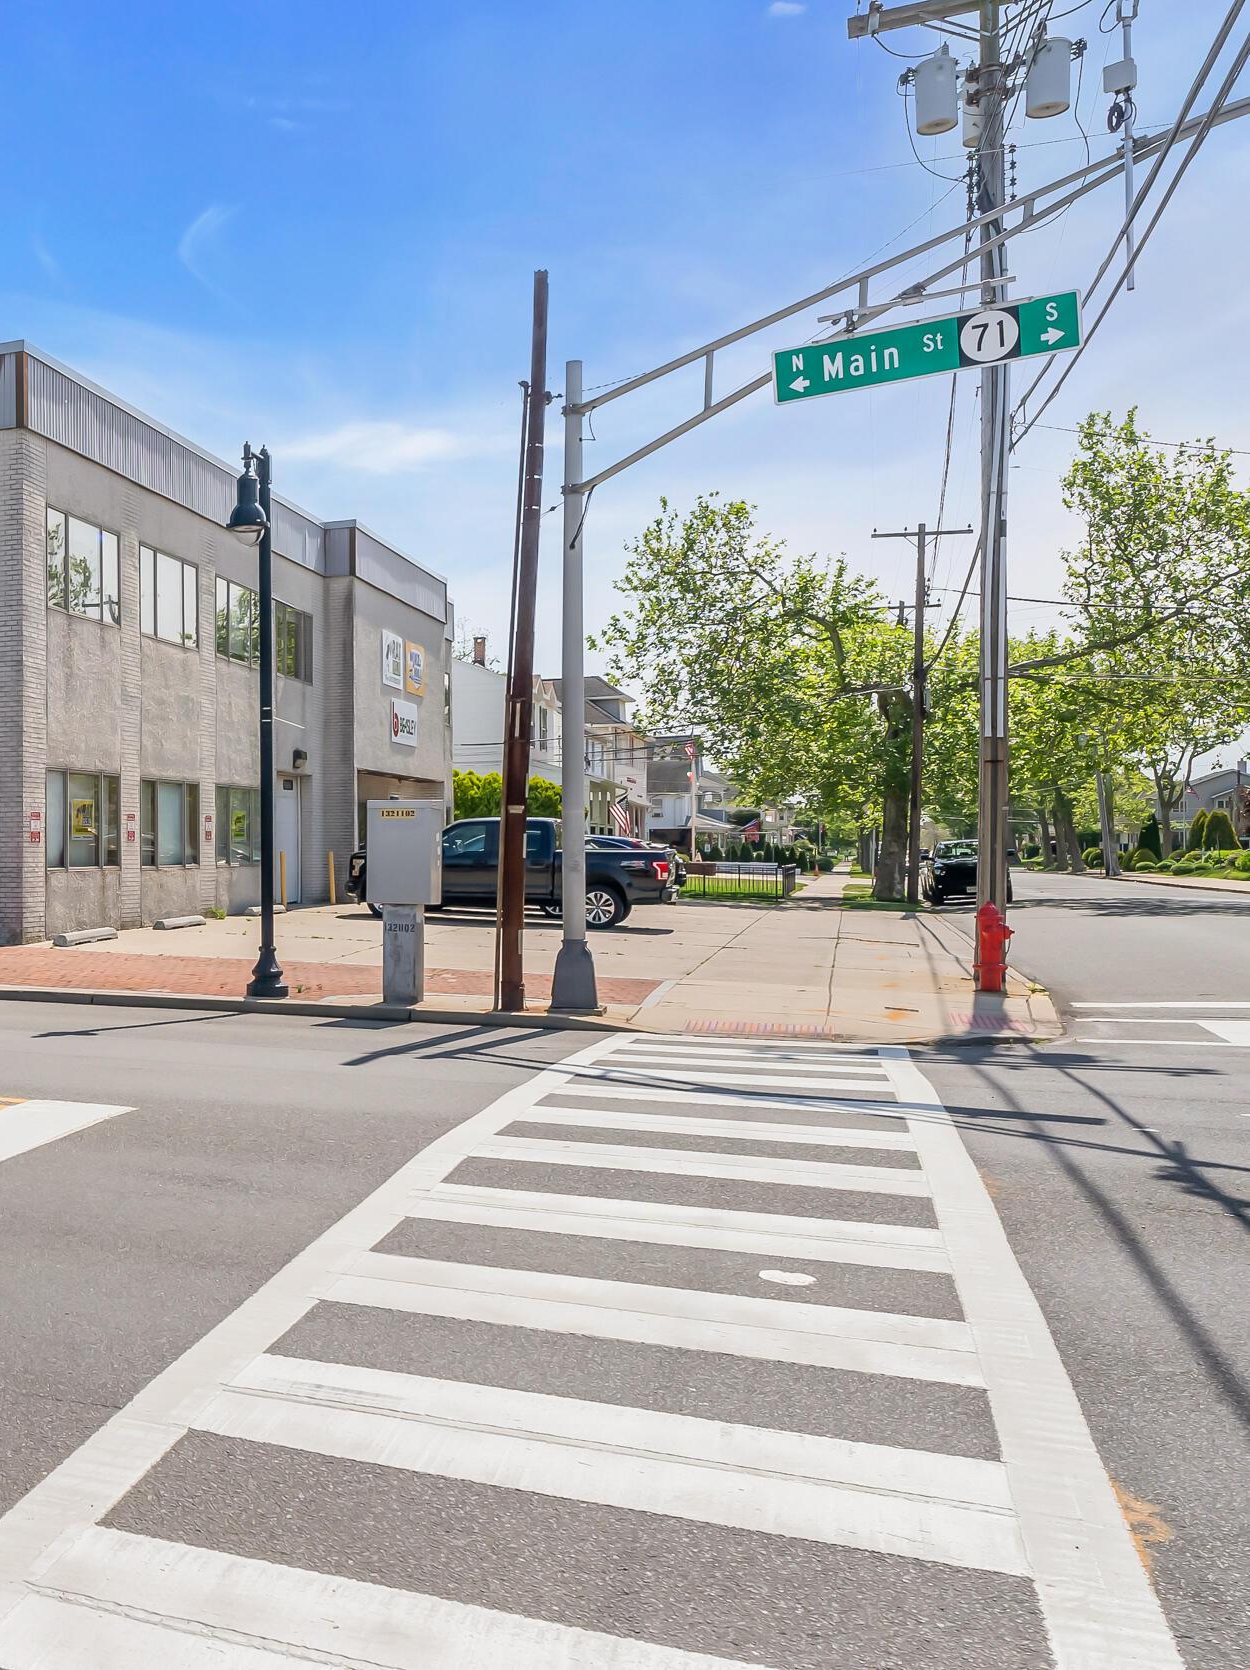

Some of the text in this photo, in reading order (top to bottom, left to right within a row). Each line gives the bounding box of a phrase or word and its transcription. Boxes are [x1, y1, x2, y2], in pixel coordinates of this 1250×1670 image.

[1045, 301, 1059, 322] S
[971, 319, 1005, 353] 71
[791, 353, 804, 373] N
[822, 332, 944, 382] Main St
[399, 716, 417, 736] BEASLEY
